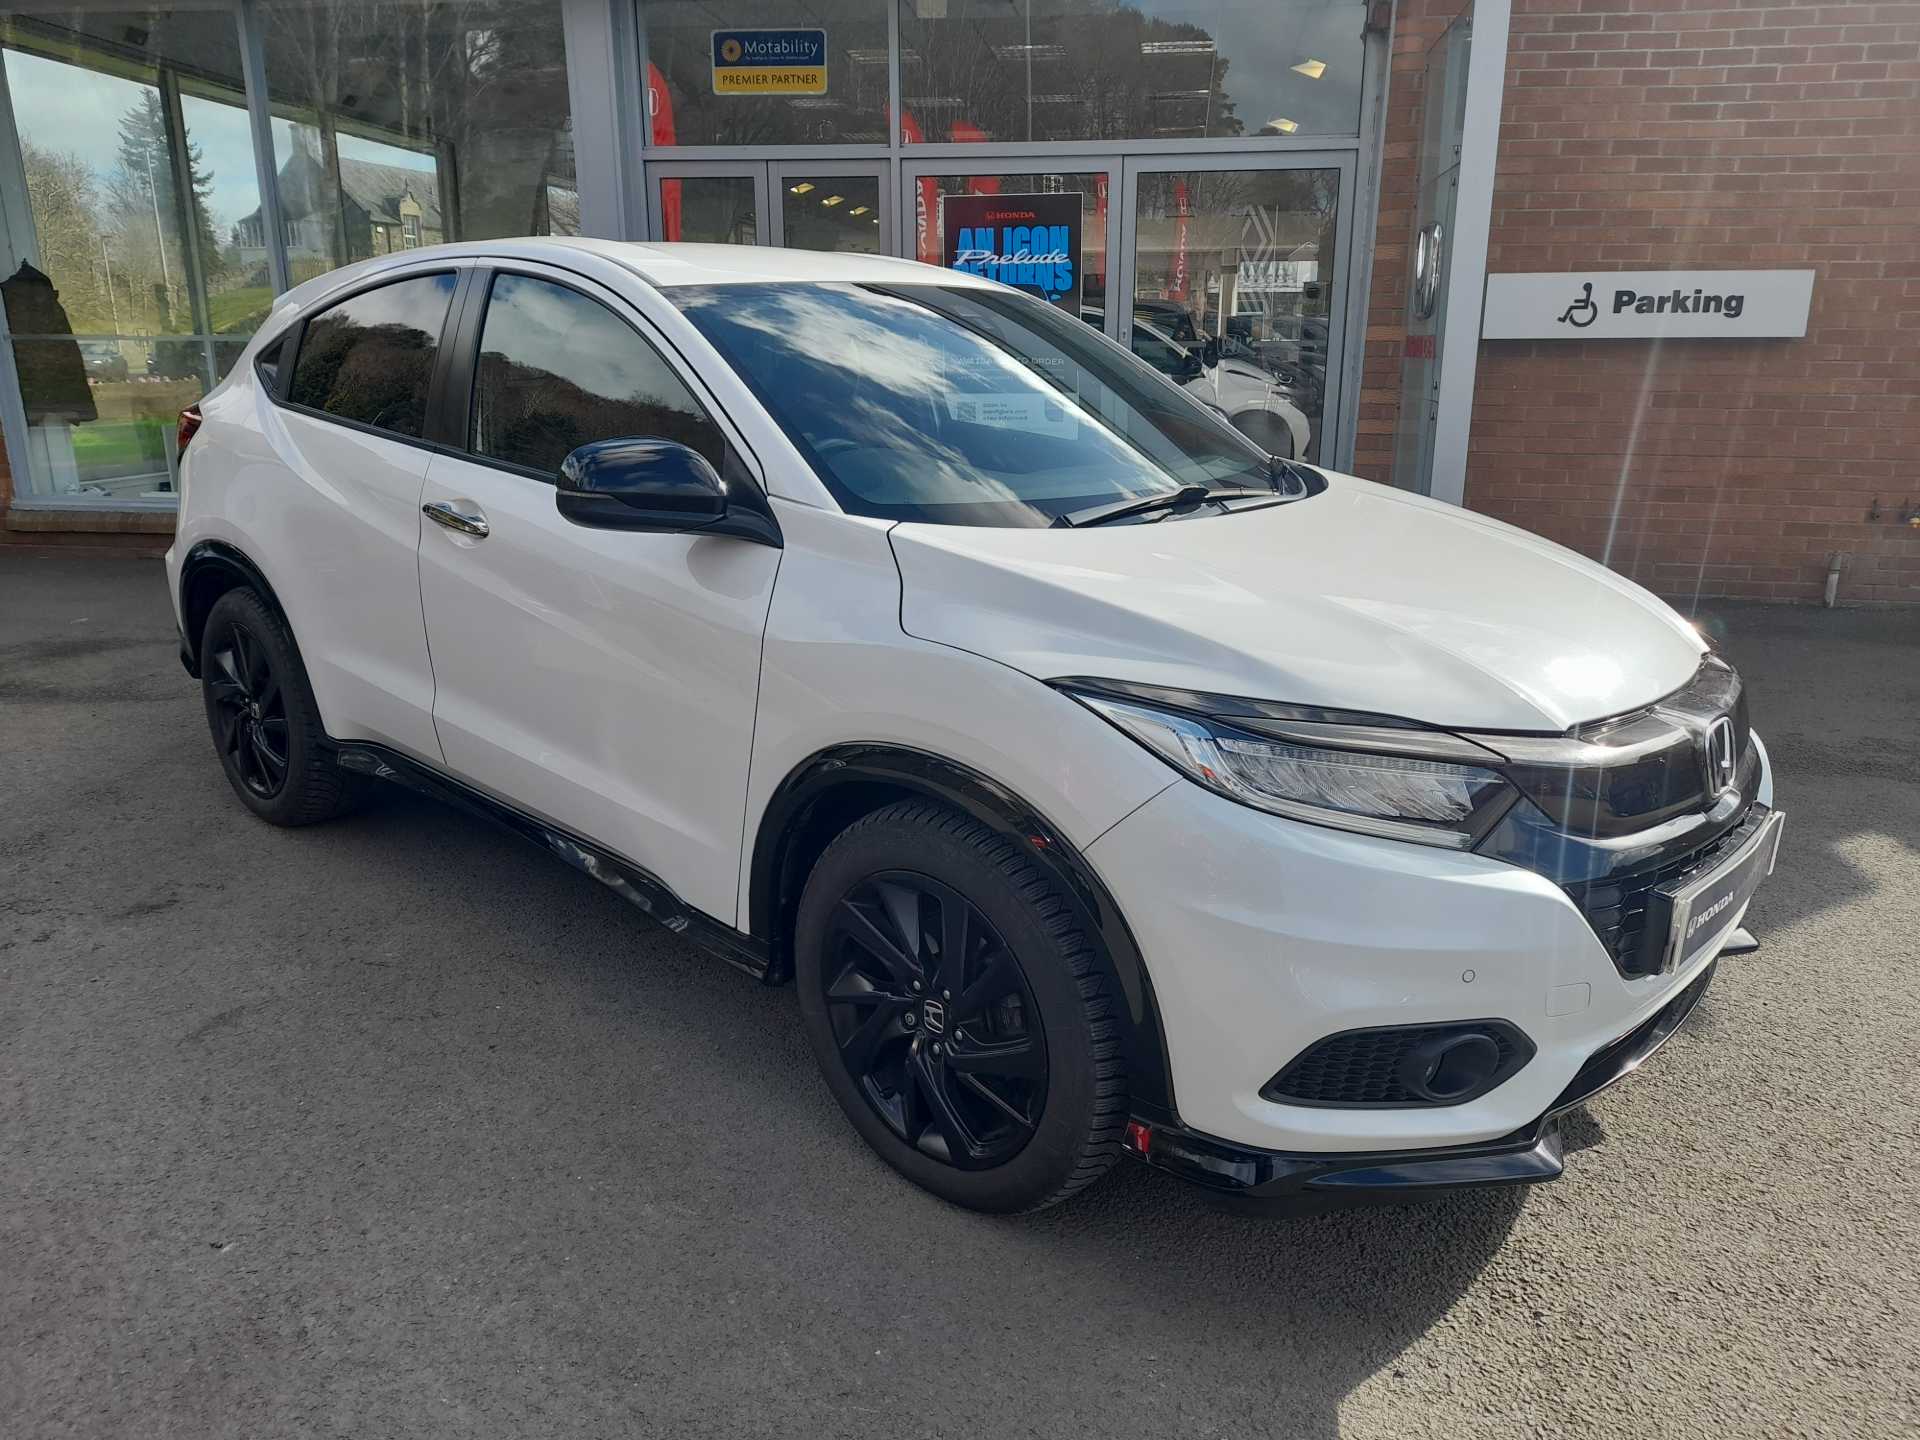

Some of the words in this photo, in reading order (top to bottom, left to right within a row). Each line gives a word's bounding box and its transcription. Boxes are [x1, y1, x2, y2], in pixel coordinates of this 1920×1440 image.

[744, 39, 818, 57] Motability
[722, 74, 768, 86] PREMIER
[771, 74, 818, 85] PARTNER
[996, 211, 1036, 219] HONDA
[957, 228, 994, 259] AN
[1003, 226, 1069, 258] ICON
[954, 248, 1070, 265] Prelude
[1613, 289, 1744, 318] Parking
[1696, 891, 1734, 928] HONDA
